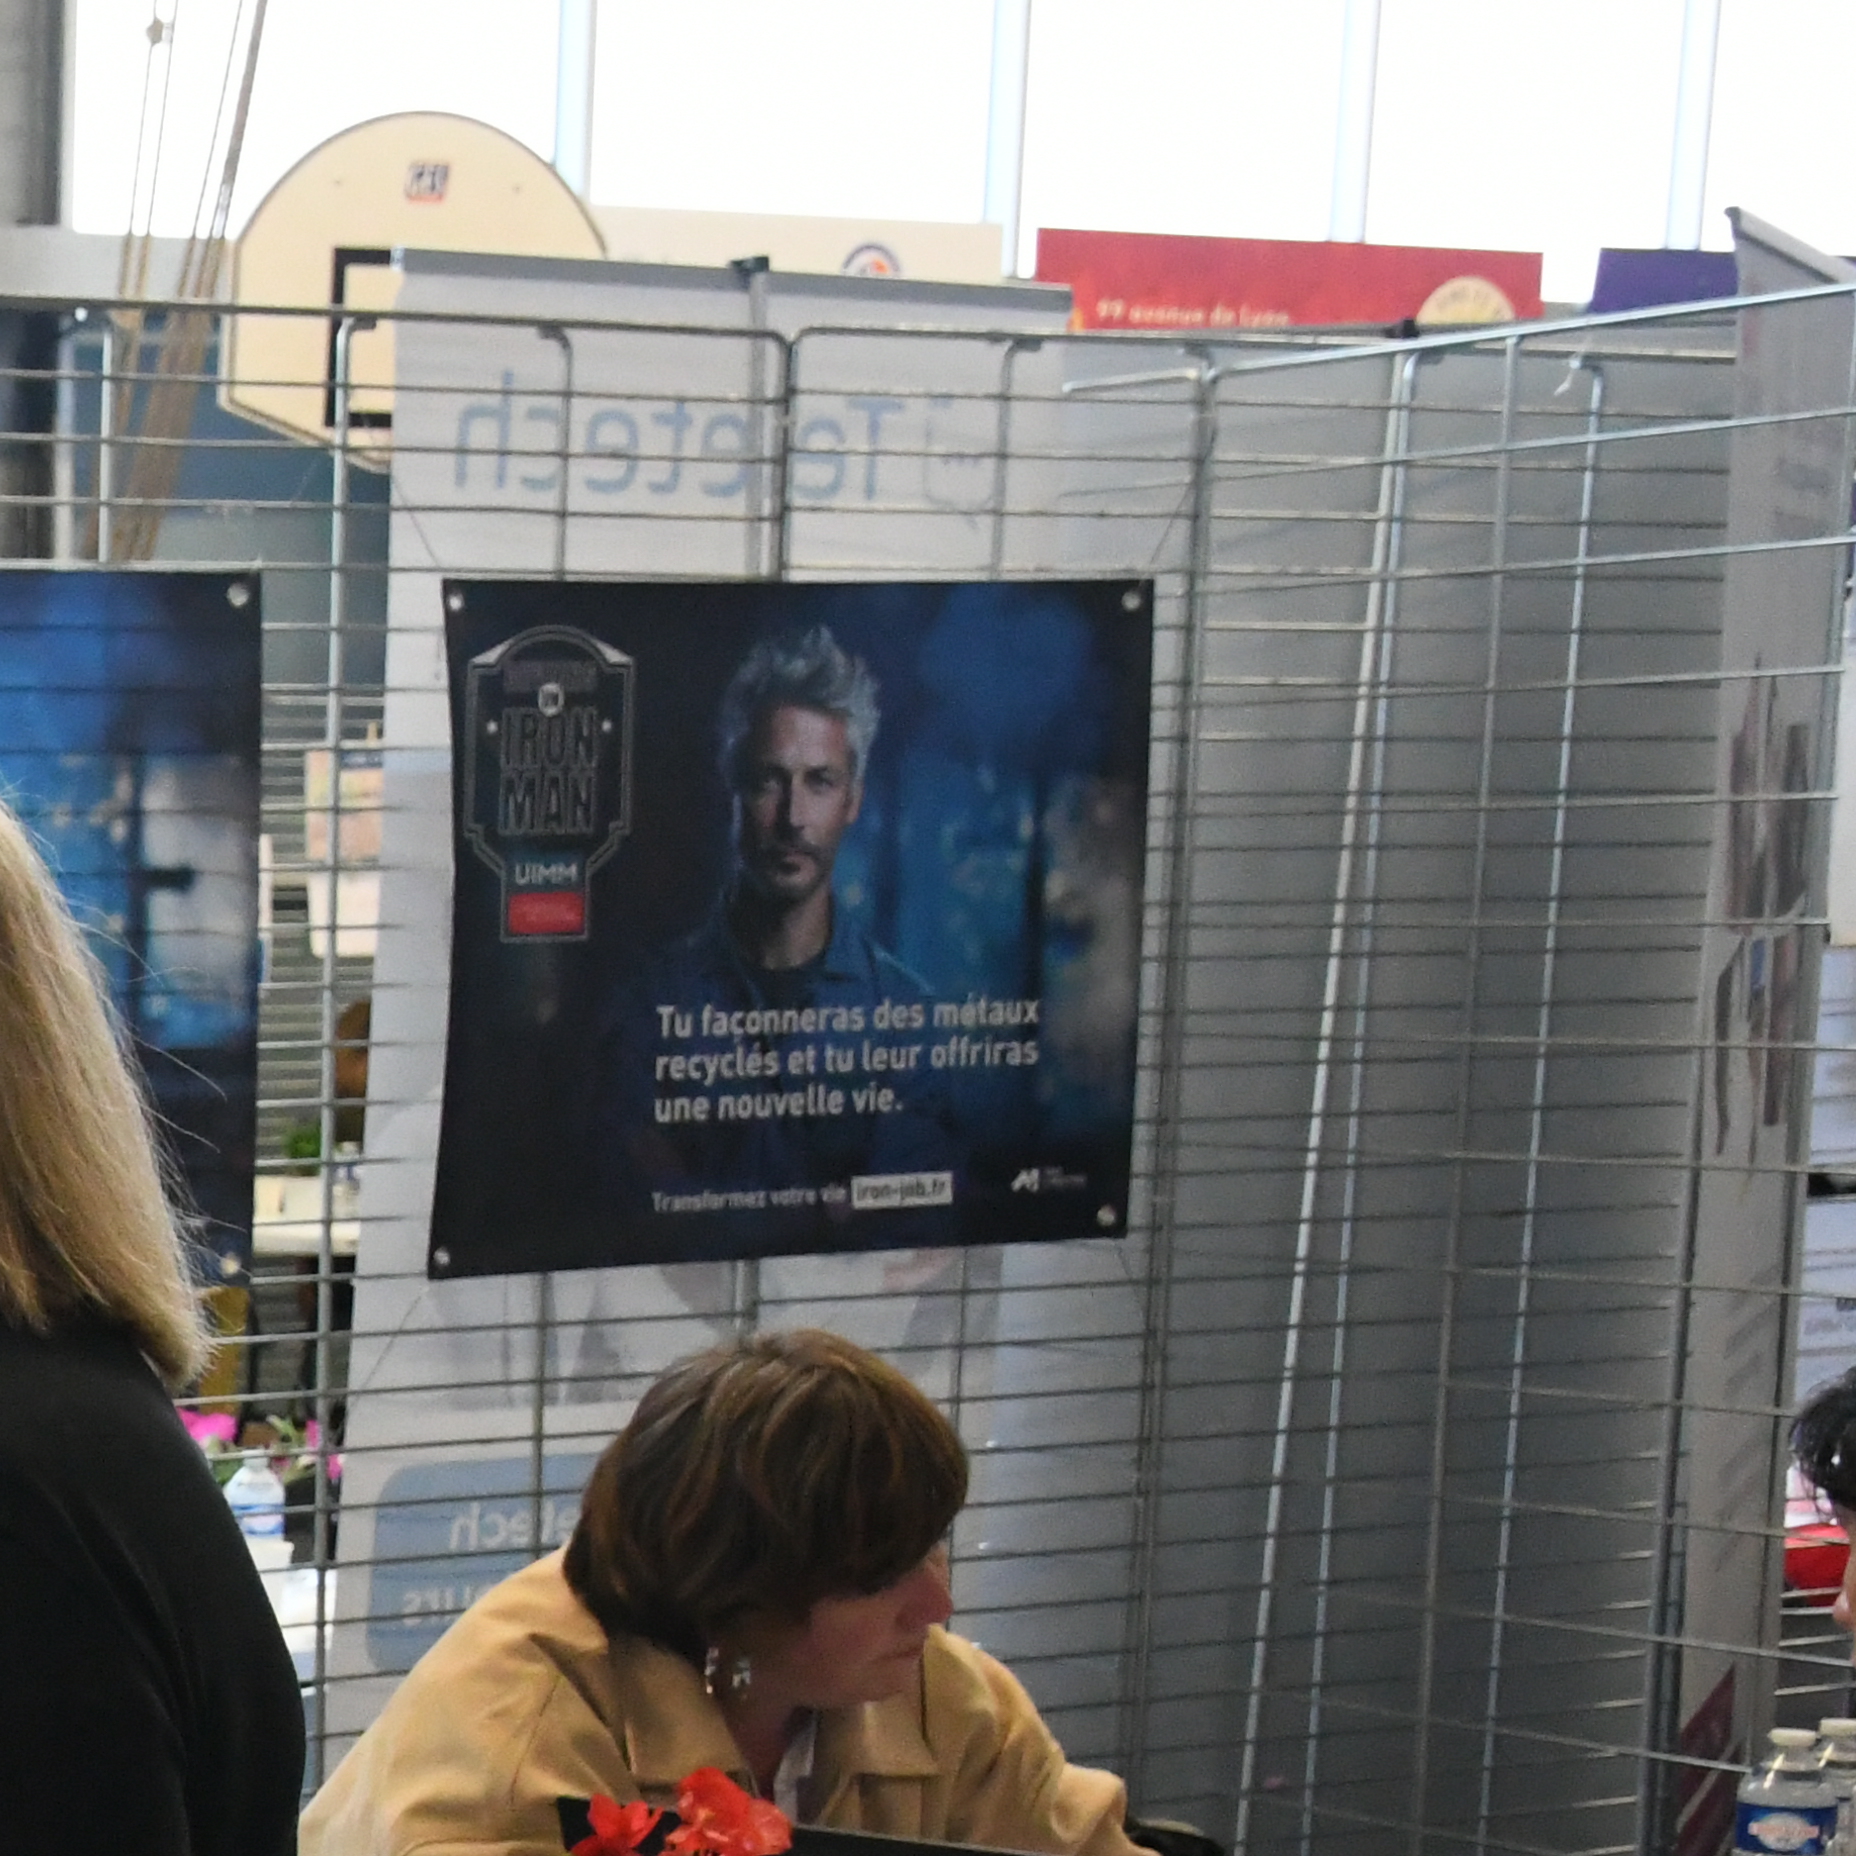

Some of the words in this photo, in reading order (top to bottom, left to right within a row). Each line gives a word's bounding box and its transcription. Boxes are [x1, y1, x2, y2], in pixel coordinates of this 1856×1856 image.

[500, 706, 598, 770] IRON
[497, 769, 595, 835] MAN
[515, 862, 578, 886] UIMM
[655, 1004, 693, 1040] Tu
[701, 1003, 865, 1047] façonneras
[872, 997, 925, 1032] des
[933, 992, 1039, 1027] métaux
[655, 1041, 779, 1087] recyclés
[787, 1045, 817, 1075] et
[825, 1042, 855, 1073] tu
[861, 1039, 924, 1072] leur
[930, 1034, 1039, 1068] offriras
[654, 1093, 711, 1124] une
[717, 1082, 844, 1121] nouvelle
[851, 1081, 904, 1114] vie.
